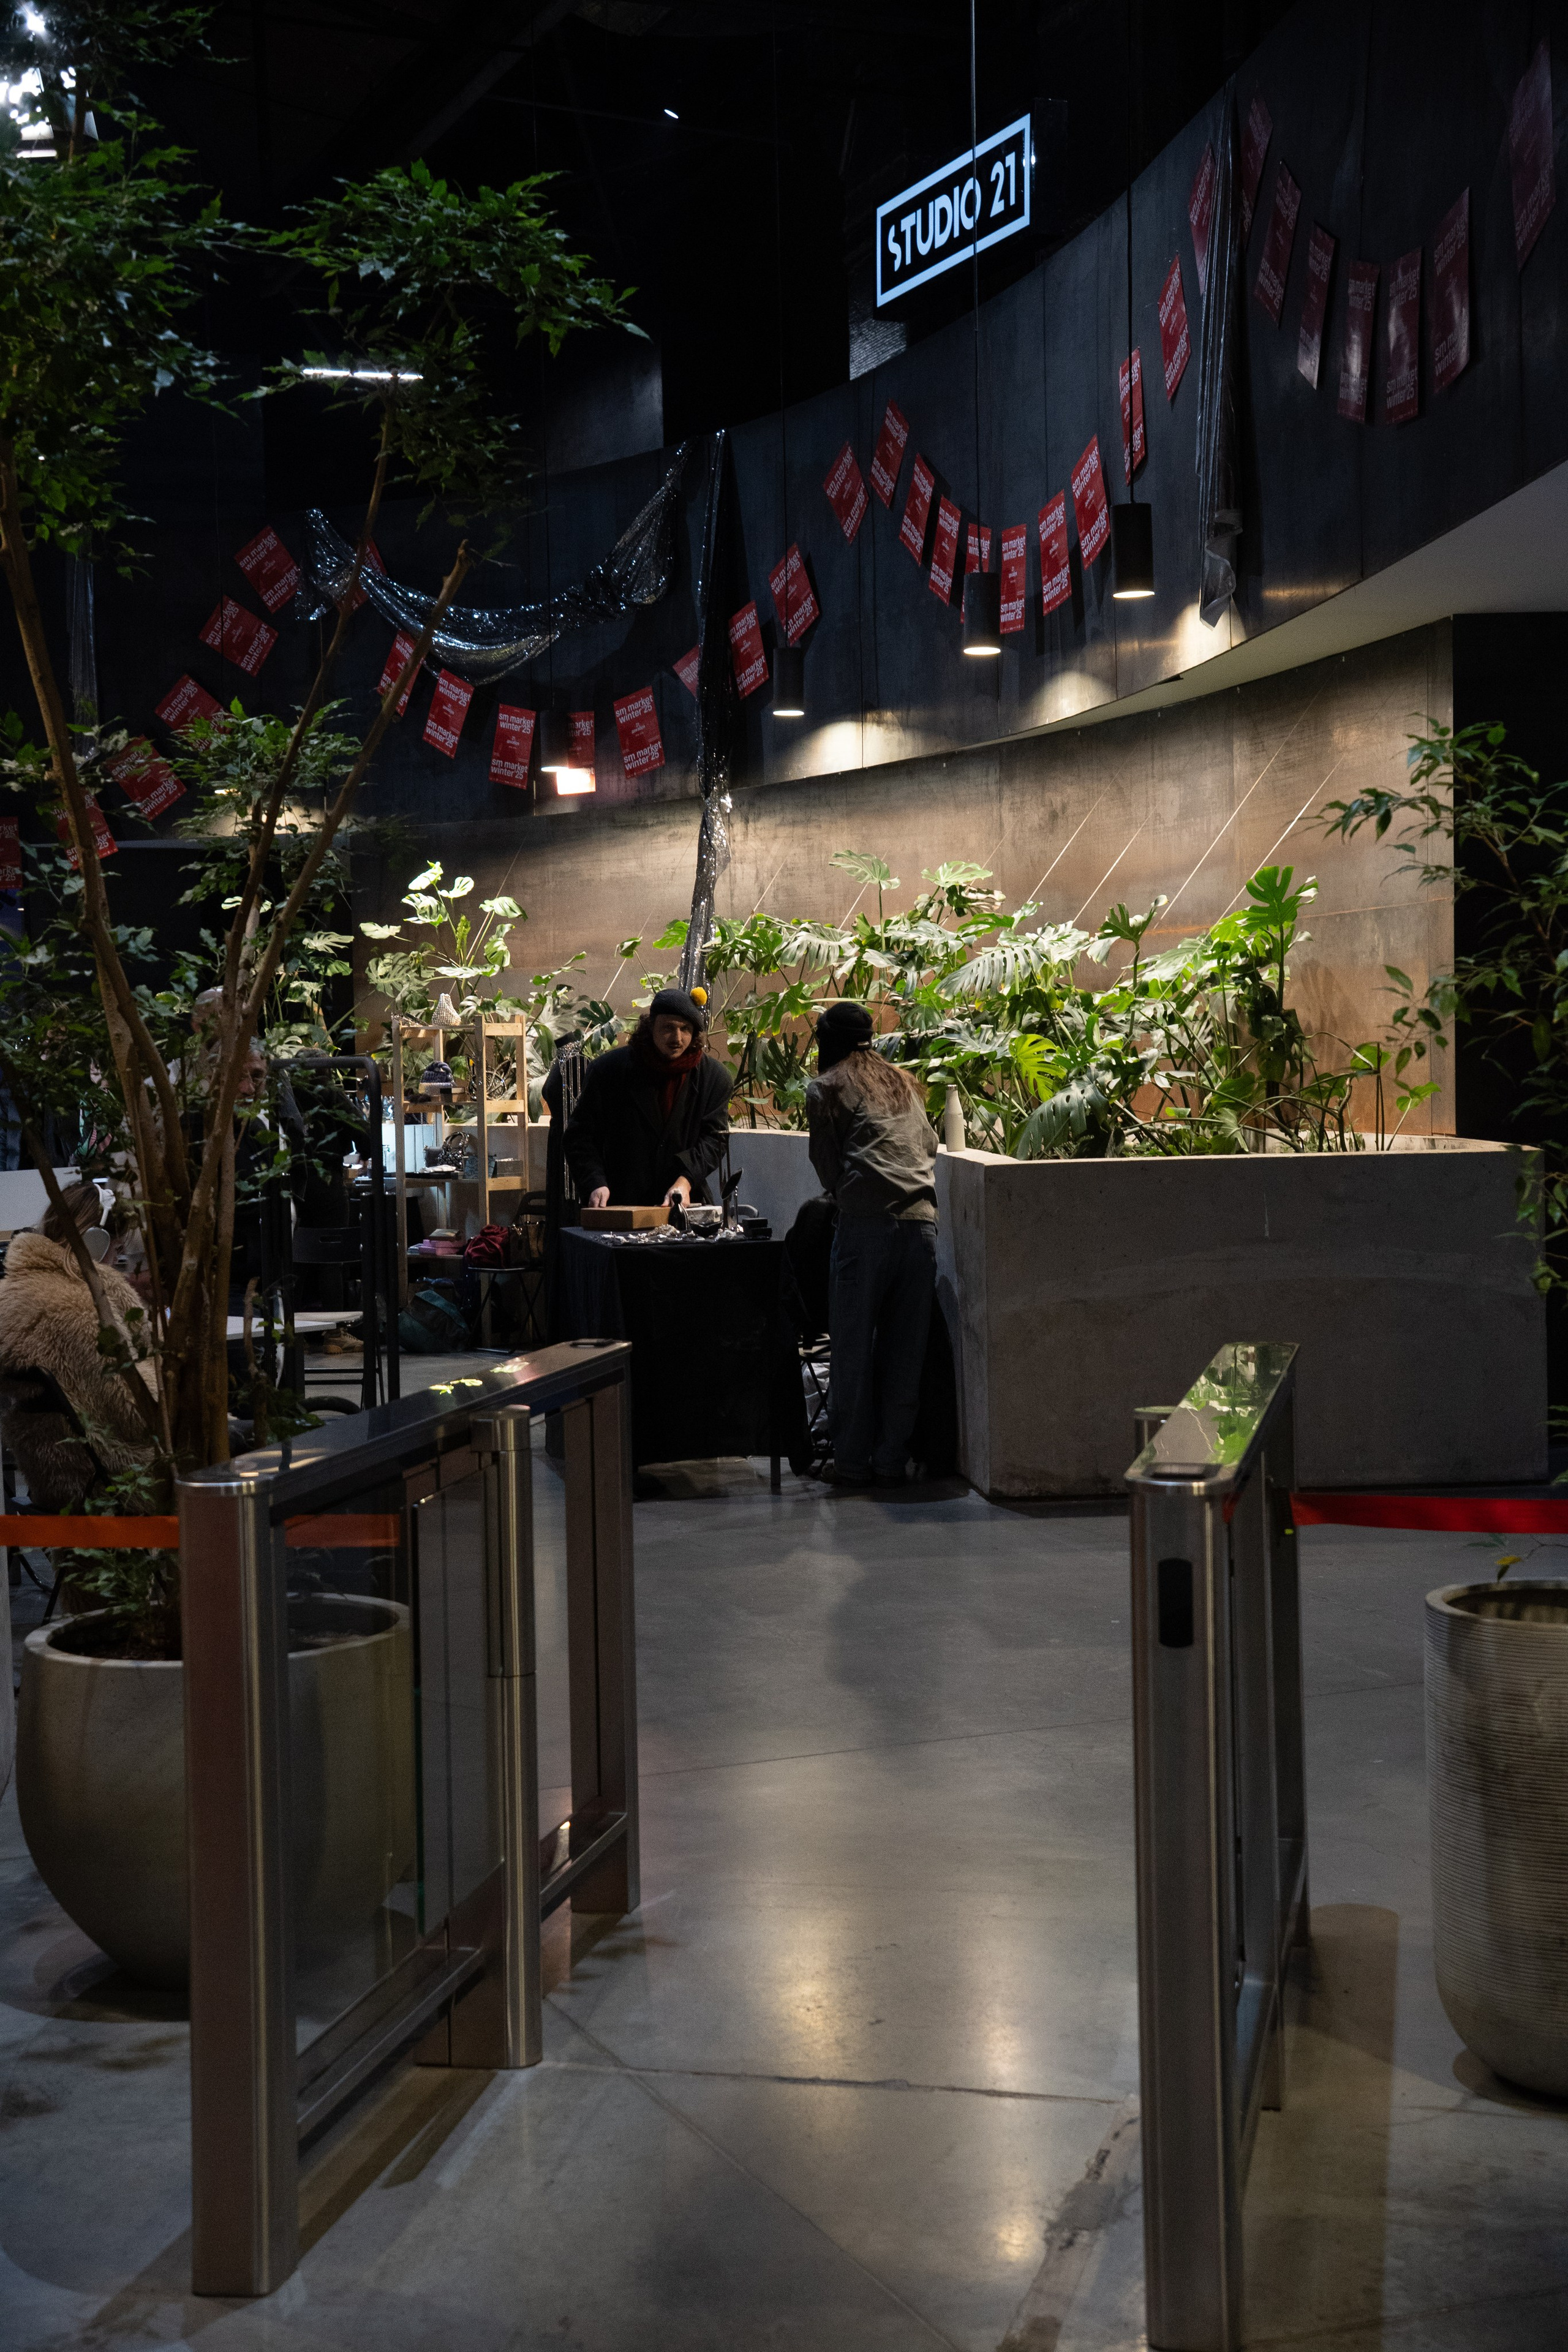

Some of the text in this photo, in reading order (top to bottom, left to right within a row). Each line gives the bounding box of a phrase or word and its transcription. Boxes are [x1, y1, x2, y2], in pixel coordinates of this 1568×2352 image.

[888, 151, 1016, 272] STUDIO 21
[1072, 477, 1080, 492] sm
[1039, 521, 1046, 533] sm
[968, 535, 974, 544] sm
[1082, 533, 1090, 549] sm
[1002, 542, 1008, 552] sm
[240, 556, 251, 567] sm
[771, 577, 780, 590] sm
[1044, 581, 1052, 594] sm
[262, 590, 275, 601] sm
[1001, 604, 1008, 612] sm
[206, 631, 216, 644] sm
[240, 655, 251, 669] sm
[439, 678, 448, 687] sm
[736, 673, 745, 684] sm
[162, 707, 173, 720] sm
[616, 708, 627, 717] sm
[428, 719, 437, 730] sm
[624, 753, 636, 763] sm
